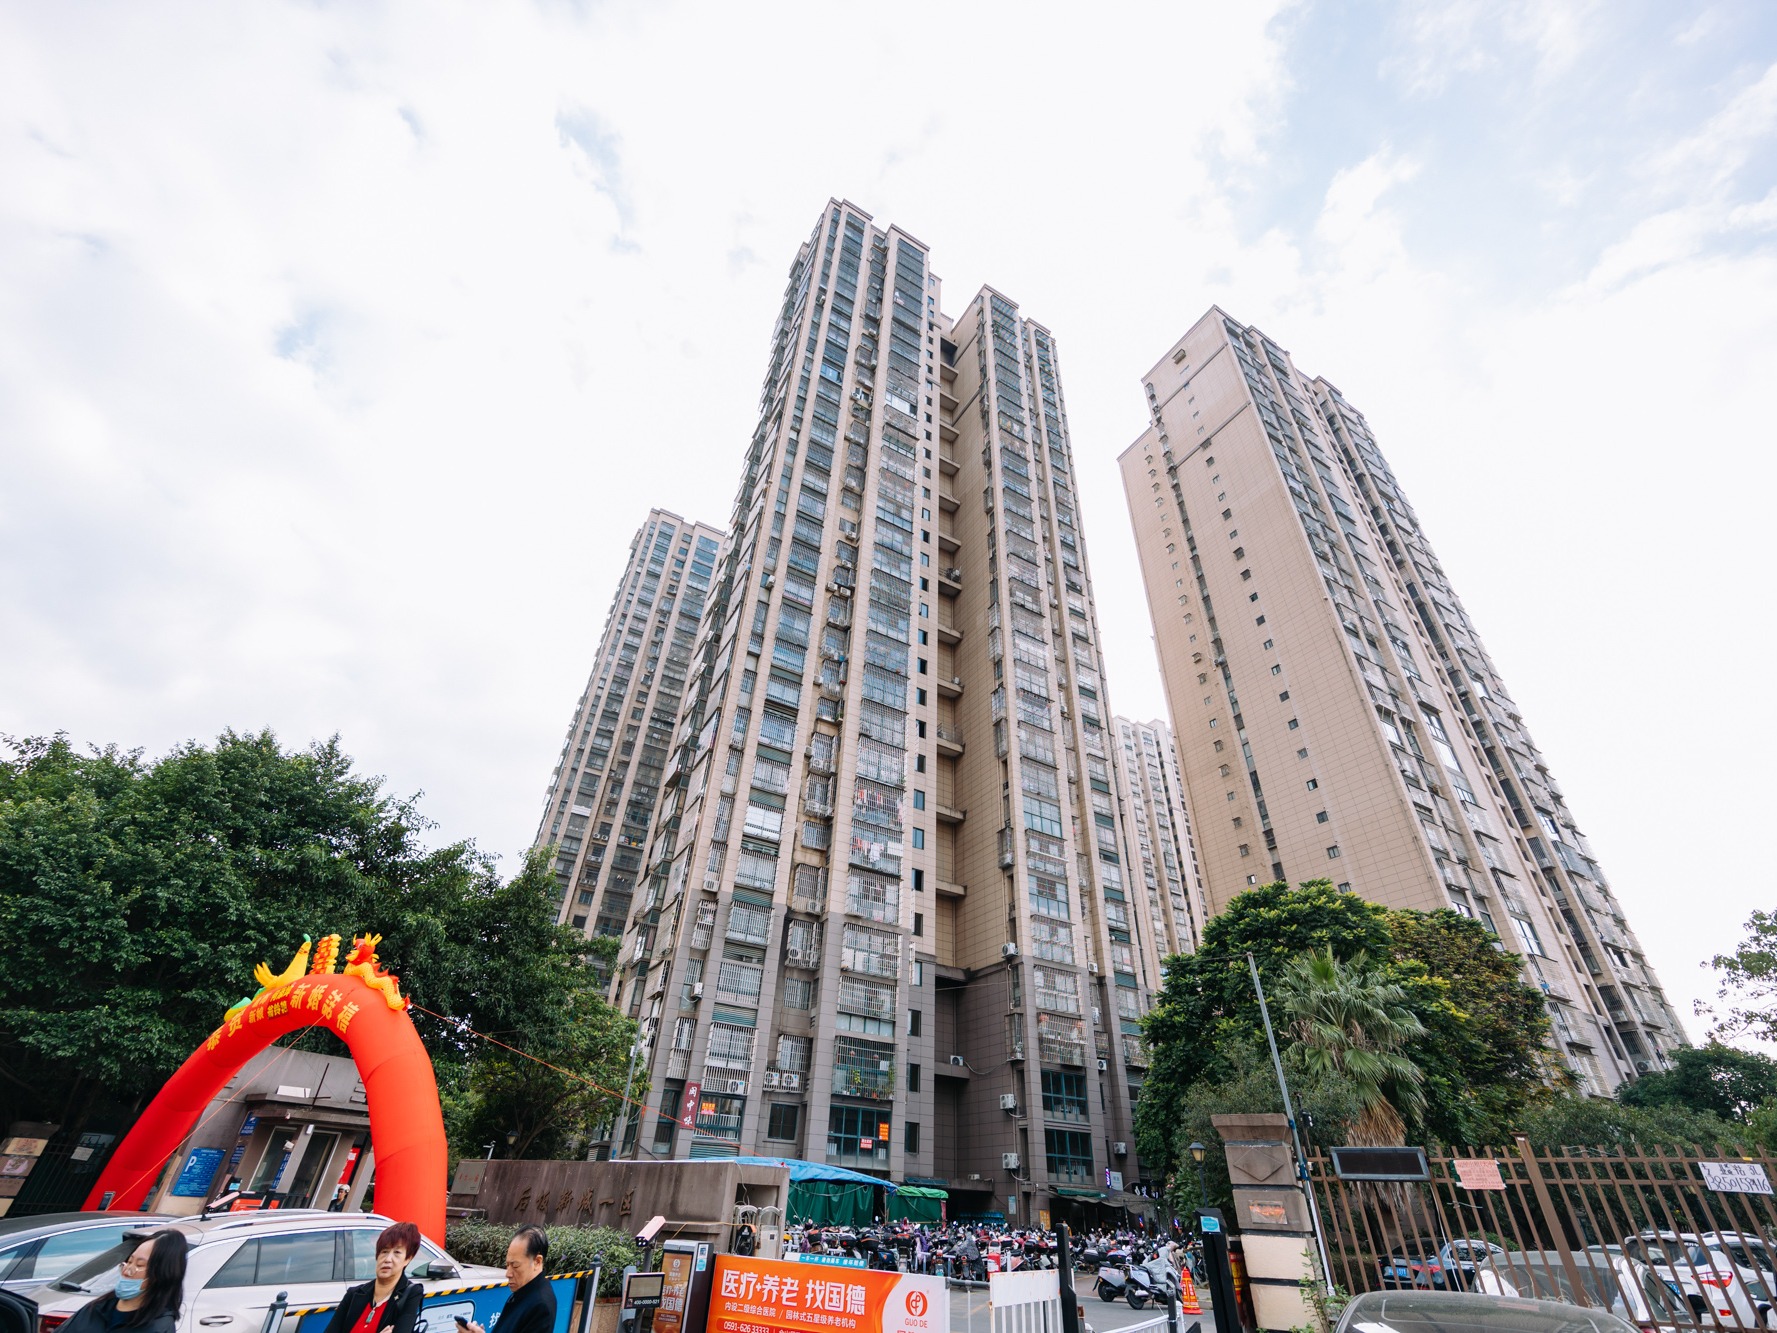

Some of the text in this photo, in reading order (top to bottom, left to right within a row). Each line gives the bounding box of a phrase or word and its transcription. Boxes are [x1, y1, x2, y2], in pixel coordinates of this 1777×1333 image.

[184, 1156, 197, 1172] P
[805, 1279, 867, 1316] 找国德
[724, 1302, 776, 1318] 内设二级综合医院
[785, 1311, 857, 1329] 园林式五星级养老机构
[904, 1317, 928, 1328] GUO DE
